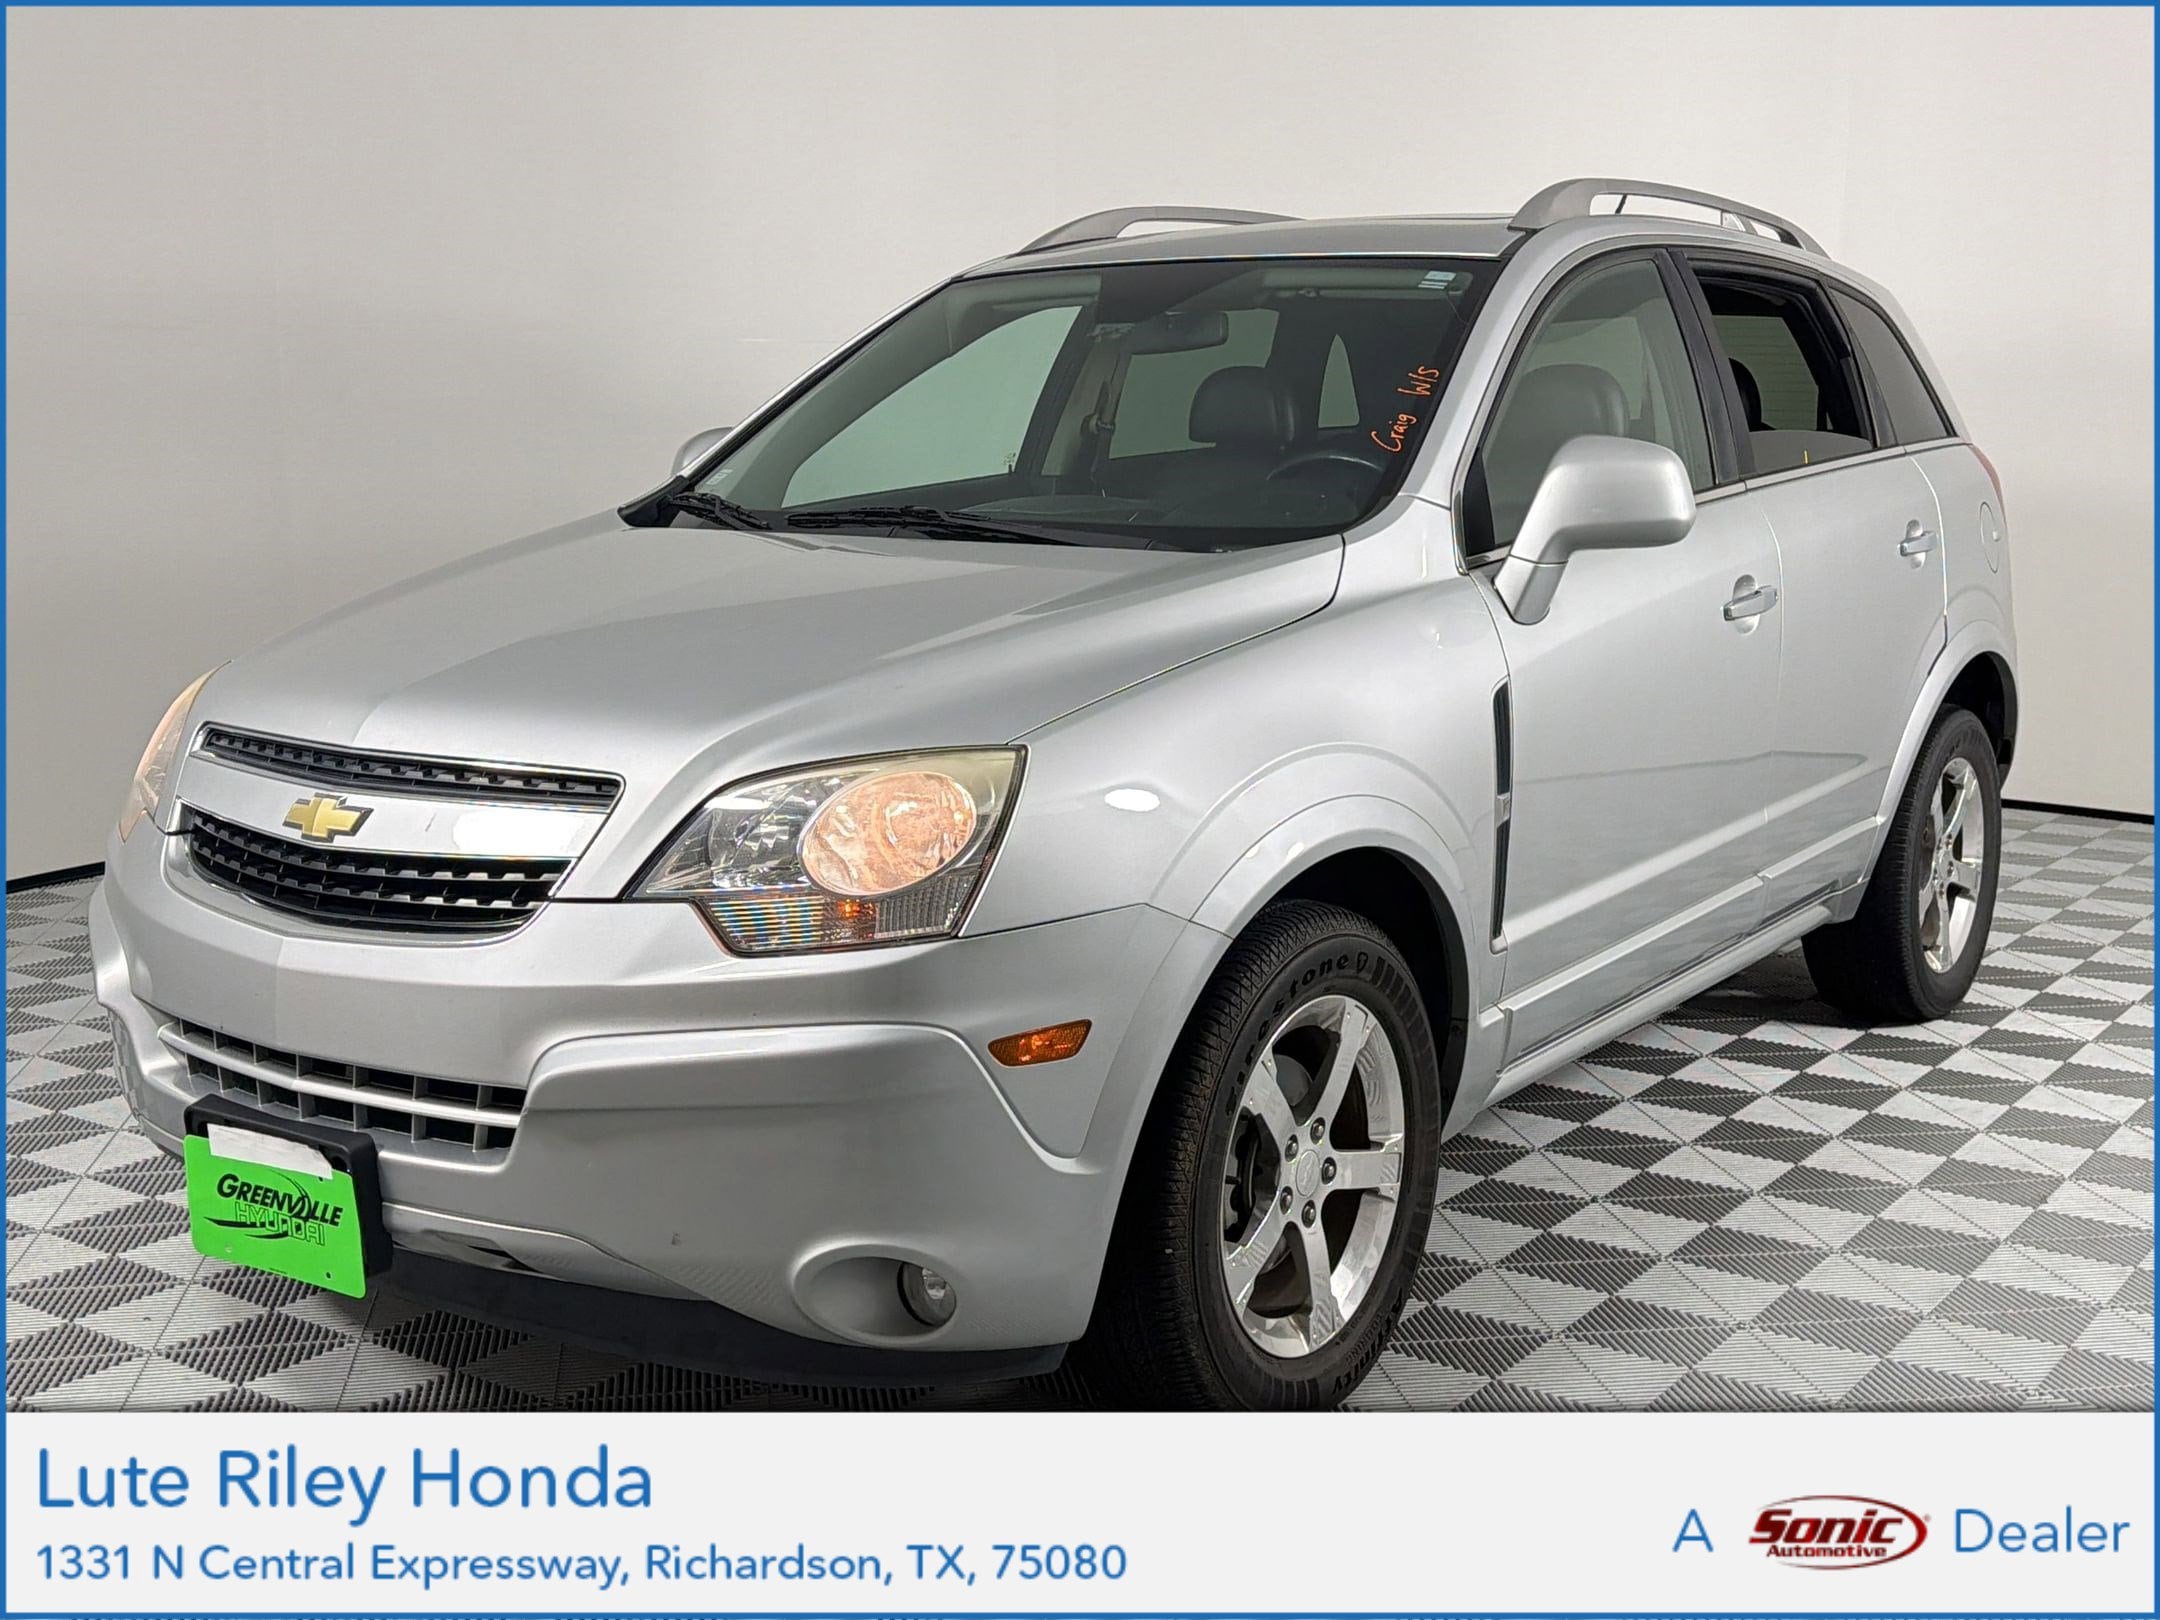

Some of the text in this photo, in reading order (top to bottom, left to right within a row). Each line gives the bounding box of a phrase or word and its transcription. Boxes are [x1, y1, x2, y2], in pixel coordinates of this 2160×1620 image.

[1370, 366, 1440, 453] Craig W/S
[235, 1202, 325, 1246] HYUNDAI
